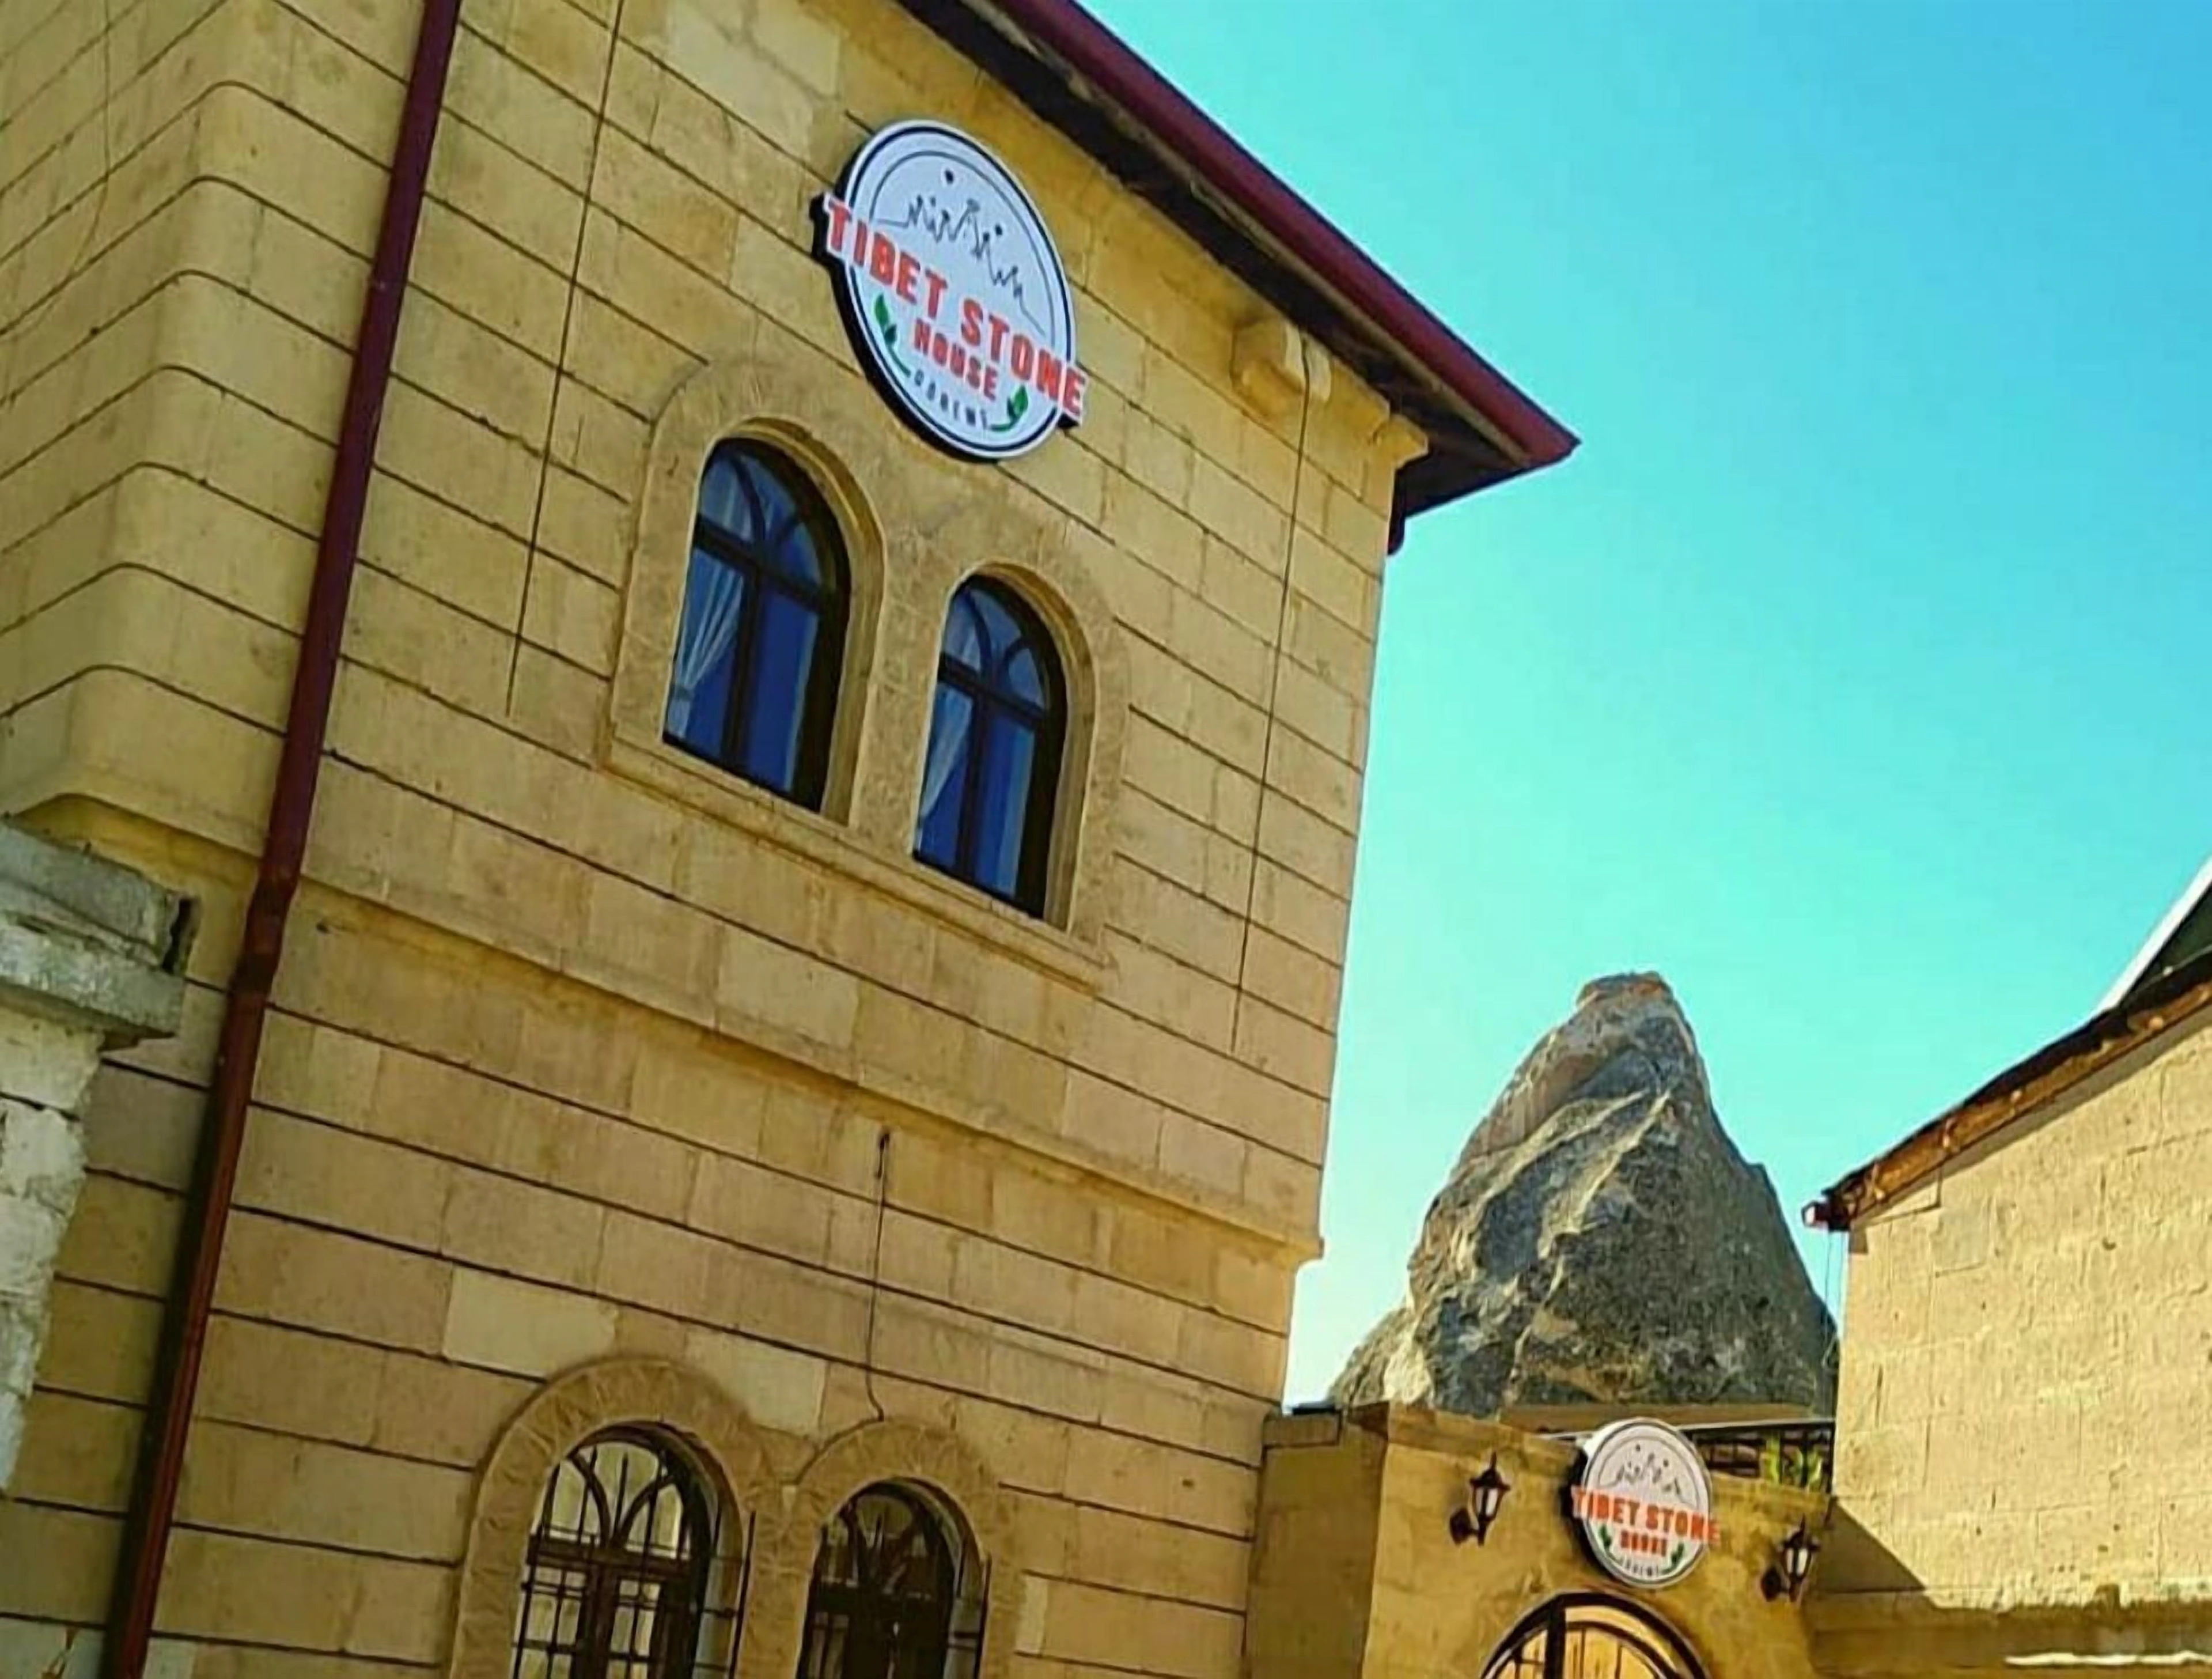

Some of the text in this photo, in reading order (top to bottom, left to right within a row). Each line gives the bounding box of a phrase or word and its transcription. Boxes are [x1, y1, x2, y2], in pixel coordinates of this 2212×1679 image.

[827, 201, 1085, 416] TIBET STONE
[914, 320, 997, 402] HOUSE
